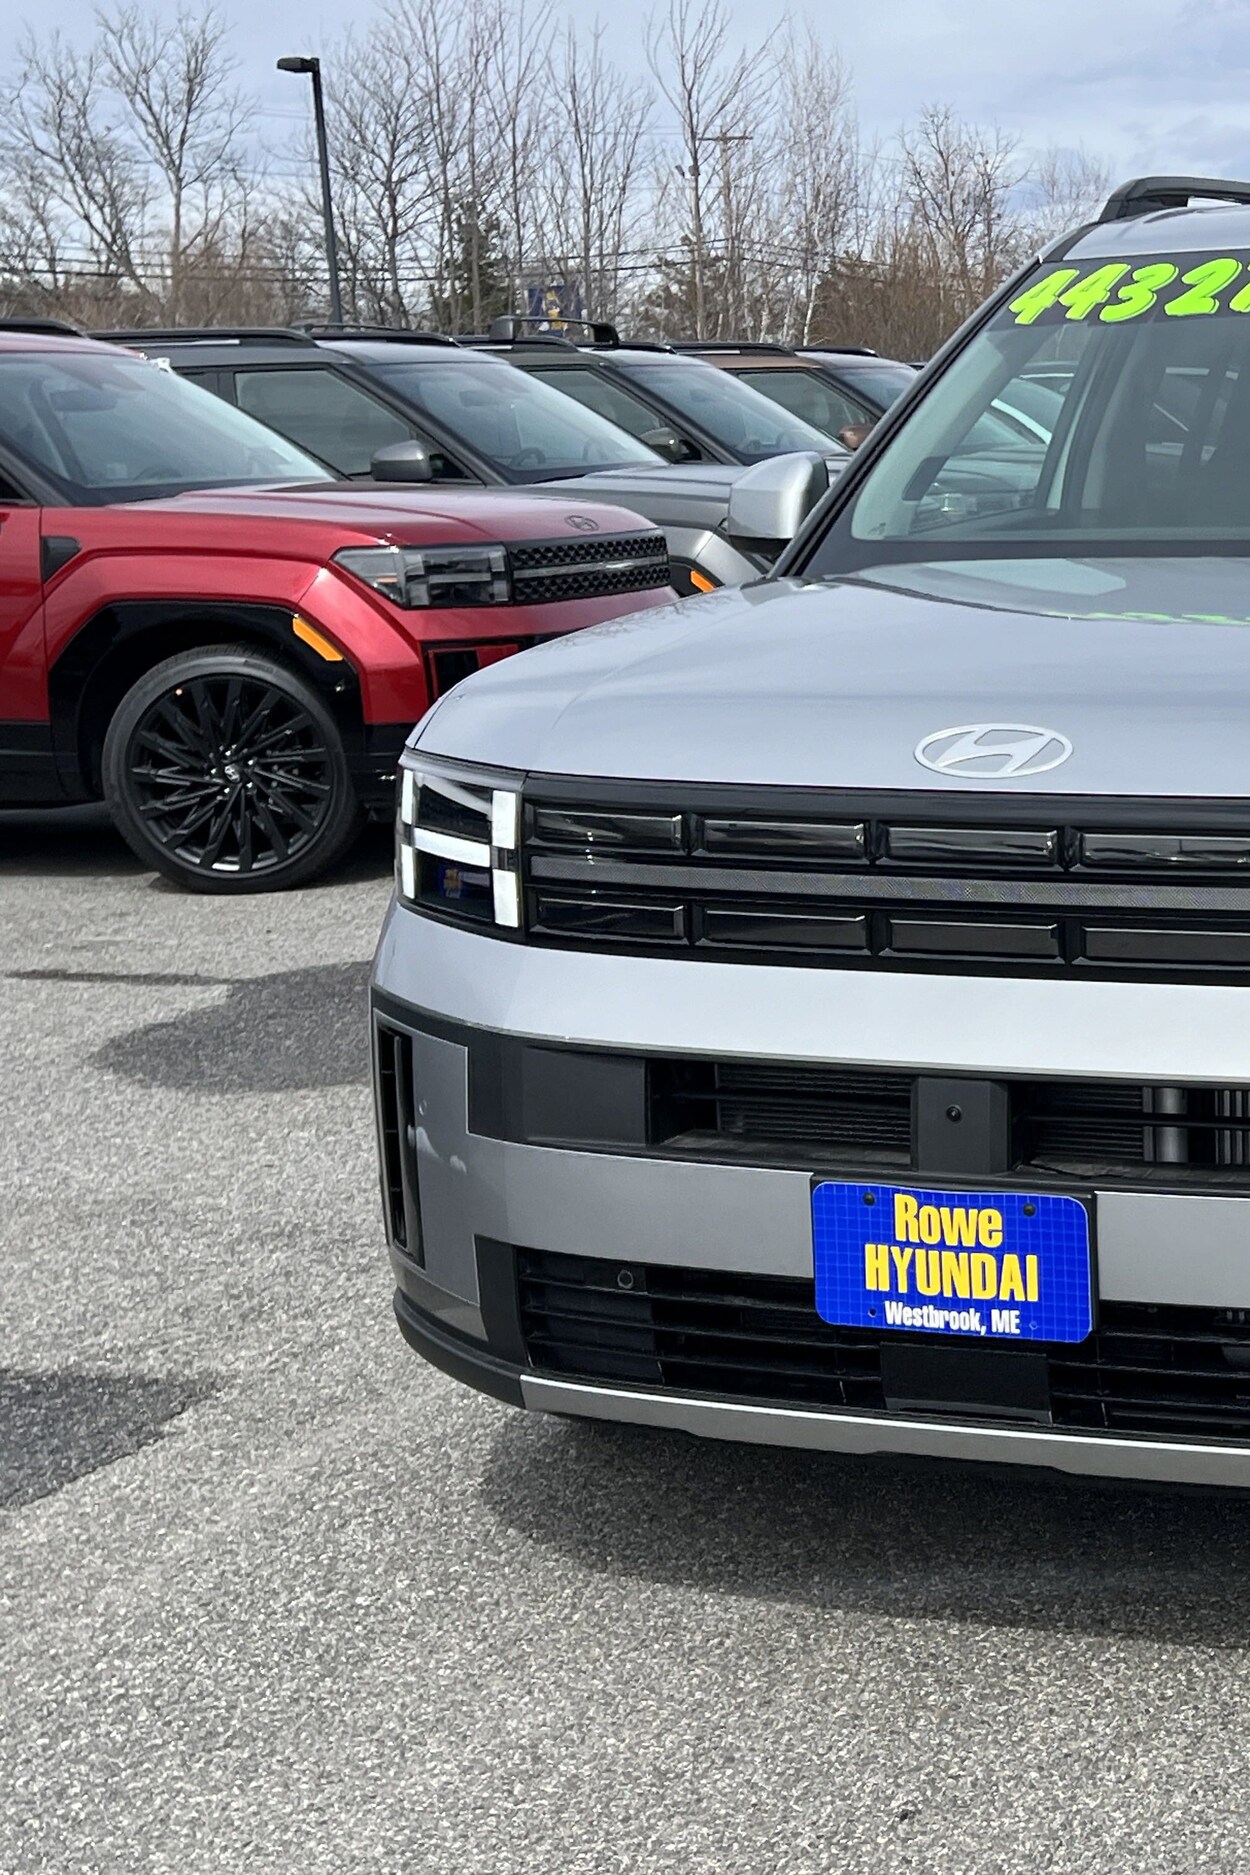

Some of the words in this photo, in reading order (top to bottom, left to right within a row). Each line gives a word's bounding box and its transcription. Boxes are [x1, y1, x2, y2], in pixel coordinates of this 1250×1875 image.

[894, 1193, 1003, 1248] Rowe
[864, 1243, 1039, 1302] HYUNDAI
[884, 1301, 987, 1336] Westbrook,
[991, 1309, 1021, 1334] ME
